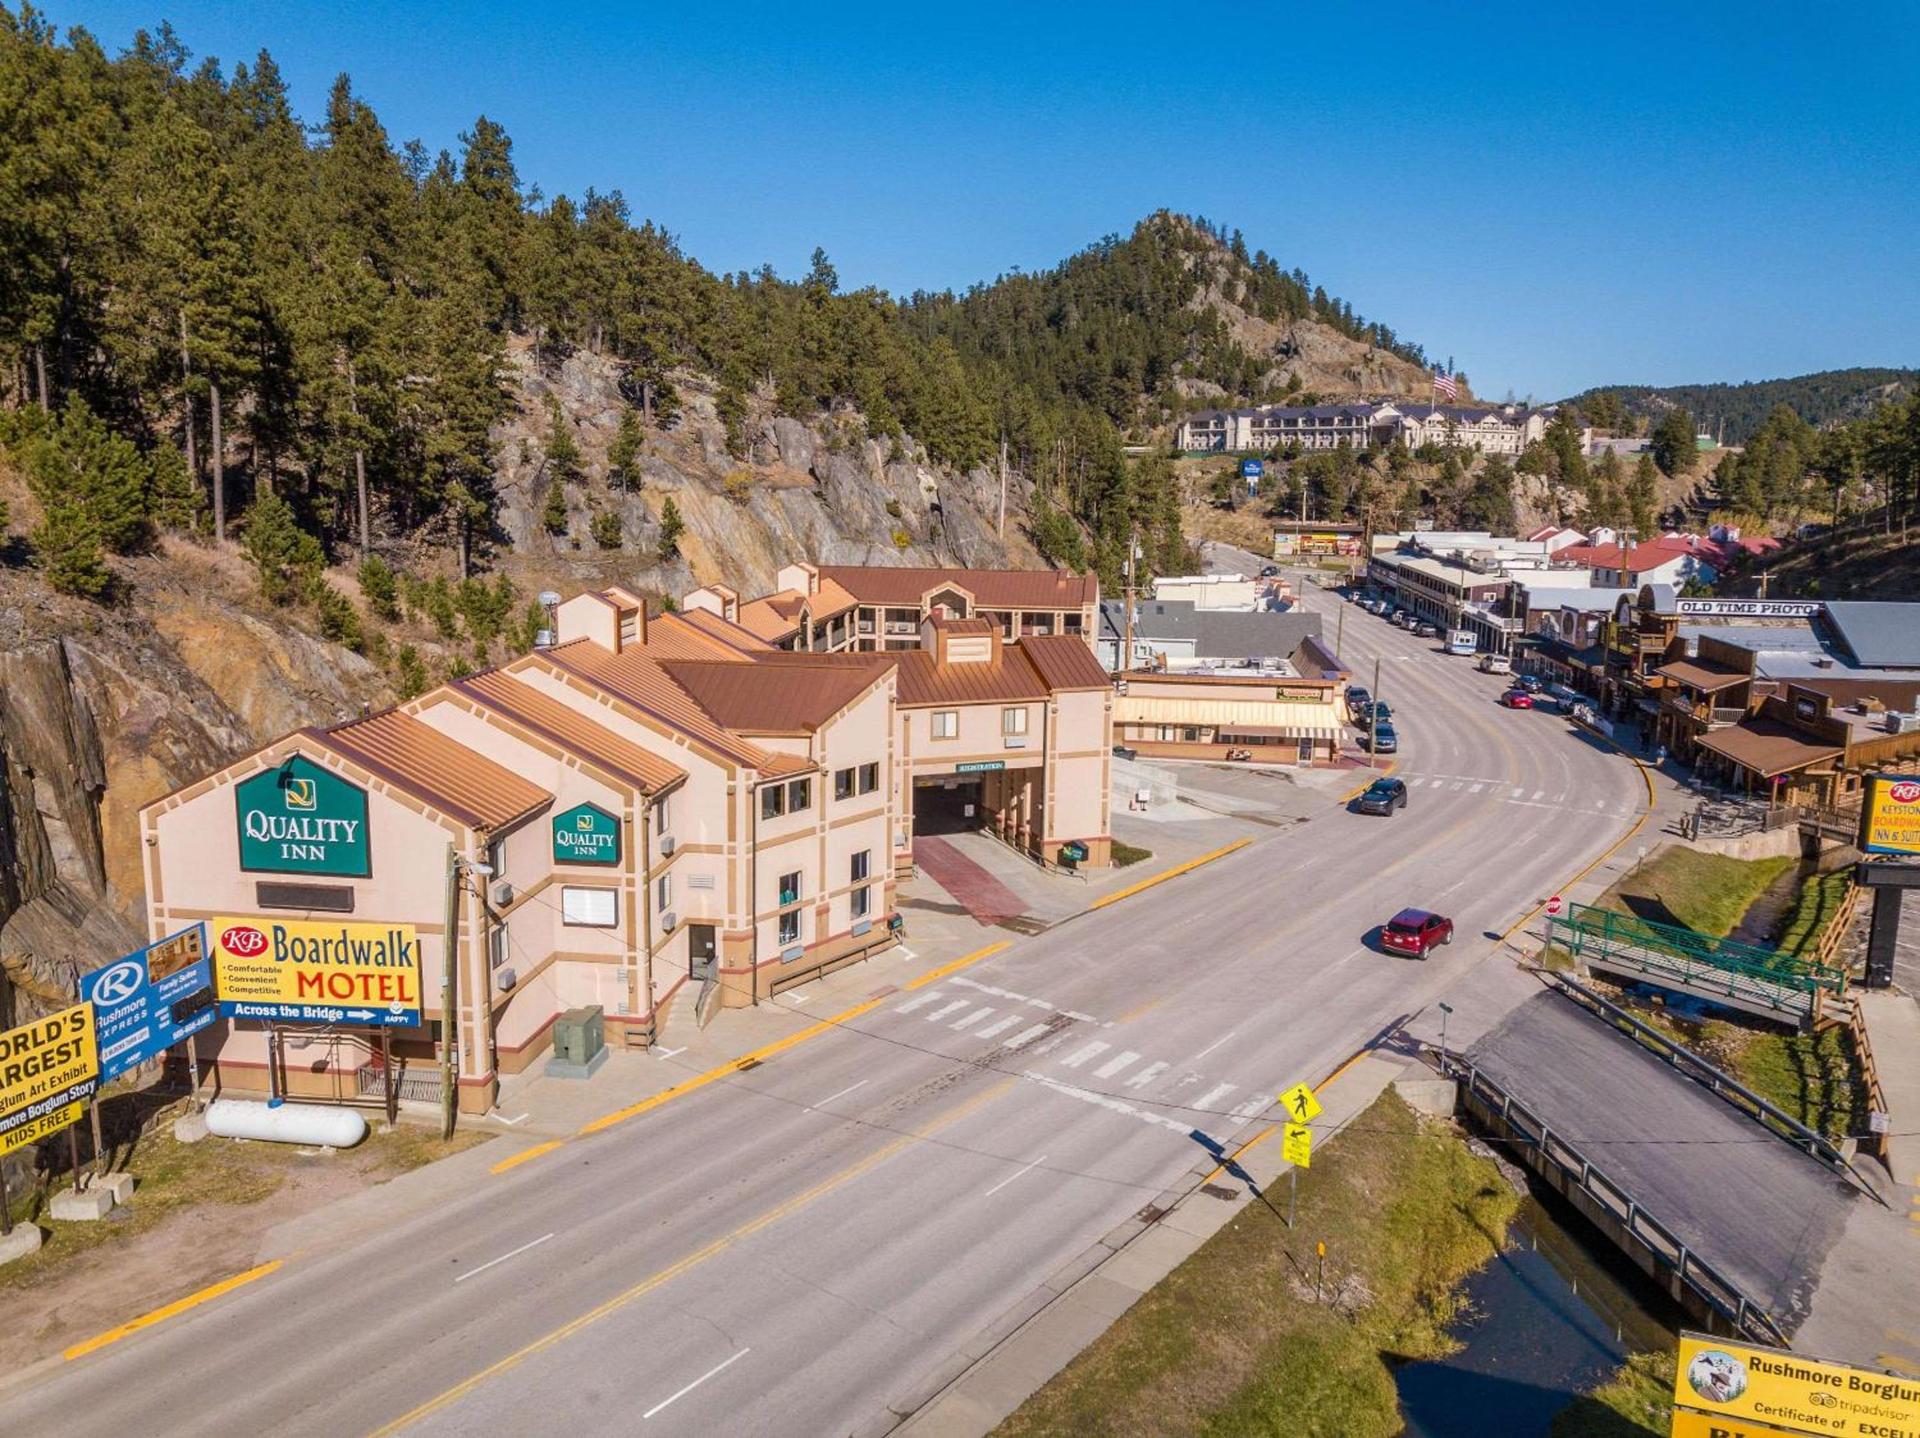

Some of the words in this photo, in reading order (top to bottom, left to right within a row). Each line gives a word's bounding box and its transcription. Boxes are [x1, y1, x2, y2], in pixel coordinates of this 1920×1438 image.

[1681, 602, 1712, 612] OLD
[1716, 603, 1757, 614] TIME
[1761, 604, 1814, 615] PHOTO
[245, 809, 359, 843] QUALITY
[556, 830, 614, 847] QUALITY
[281, 843, 325, 860] INN
[574, 846, 598, 856] INN
[224, 930, 263, 953] KB
[272, 925, 414, 967] Boardwalk
[227, 964, 283, 974] Comfortable
[228, 974, 278, 984] Convenient
[229, 985, 282, 995] Competitive
[297, 971, 414, 1002] MOTEL
[95, 997, 147, 1031] Rushmore
[235, 1003, 278, 1017] Across
[279, 1005, 300, 1018] the
[303, 1006, 344, 1022] Bridge
[30, 1081, 46, 1098] Art
[50, 1062, 88, 1088] Exhibit
[28, 1094, 69, 1118] Borglum
[69, 1079, 96, 1100] Story
[6, 1125, 36, 1148] KIDS
[40, 1108, 71, 1132] FREE
[1749, 1356, 1843, 1387] Rushmore
[1754, 1402, 1828, 1426] Certificate
[1832, 1419, 1847, 1430] of
[1839, 1400, 1910, 1421] tripadvisor
